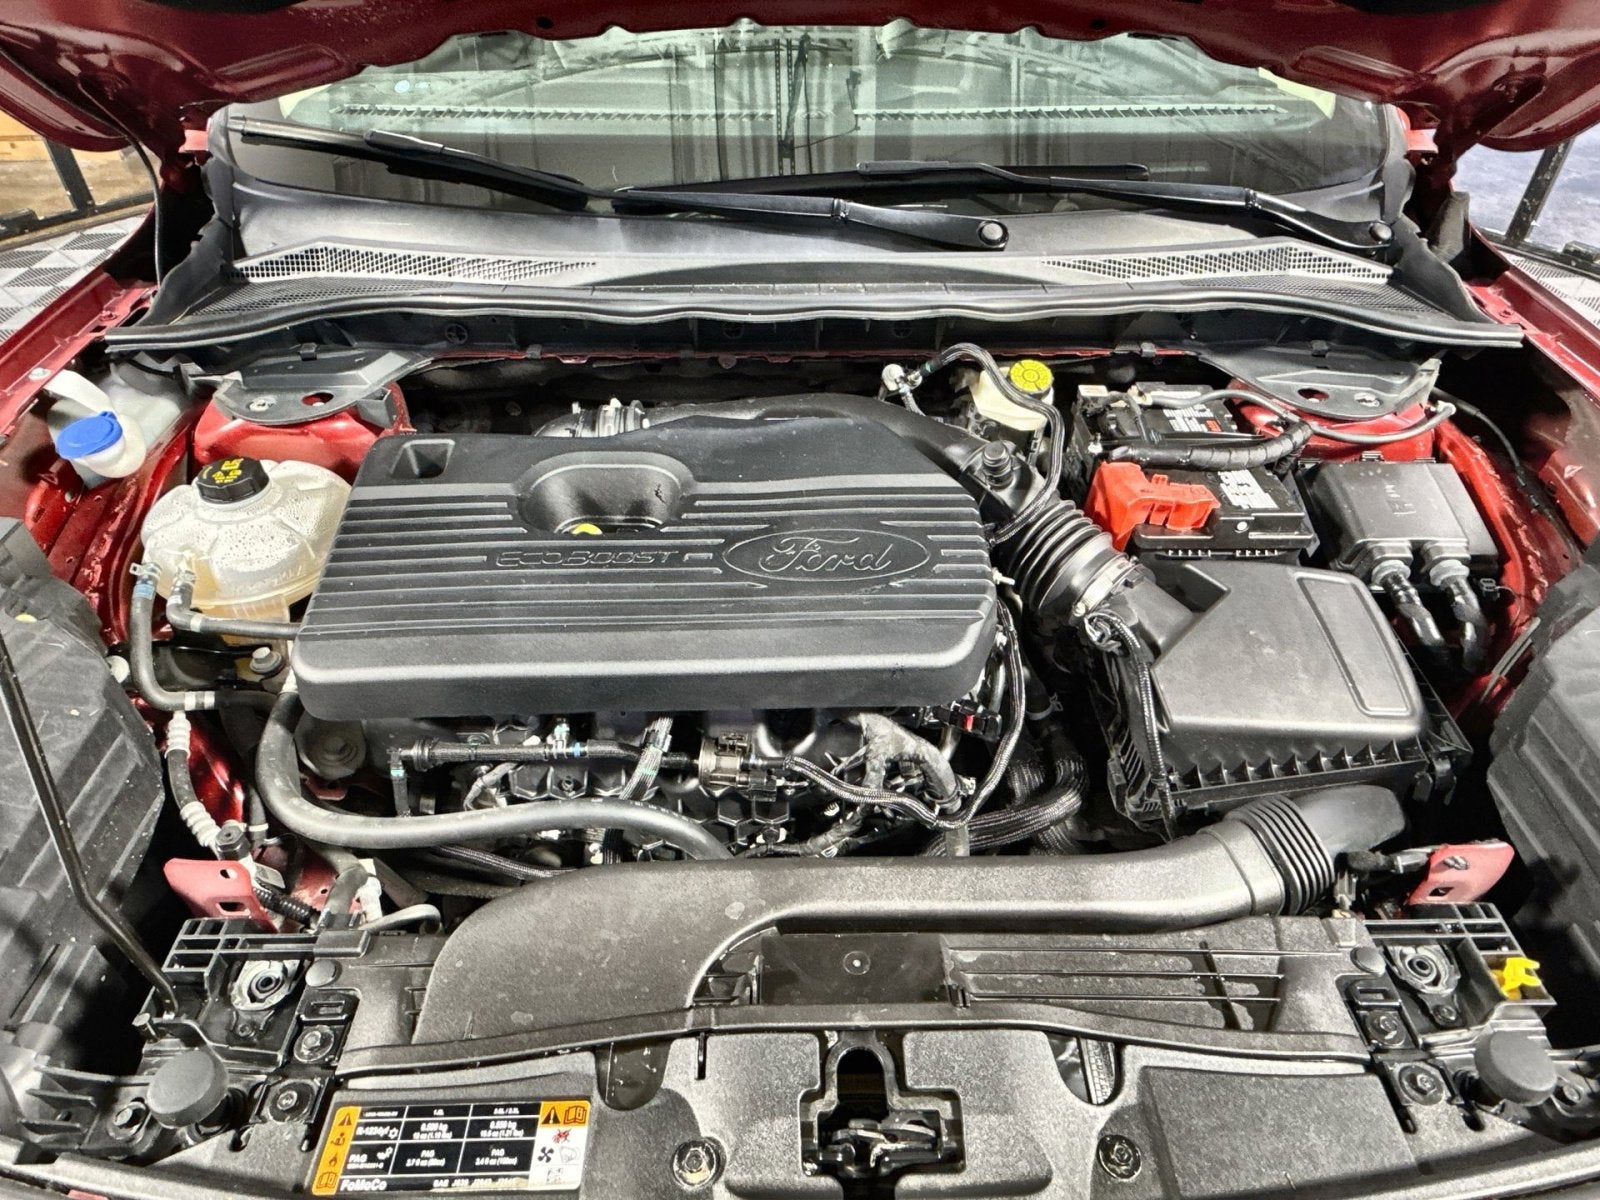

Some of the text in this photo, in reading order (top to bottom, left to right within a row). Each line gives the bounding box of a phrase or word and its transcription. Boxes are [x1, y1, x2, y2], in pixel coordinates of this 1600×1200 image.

[758, 536, 893, 573] Ford
[349, 1154, 367, 1163] PAG
[340, 1178, 387, 1191] FoMoCo
